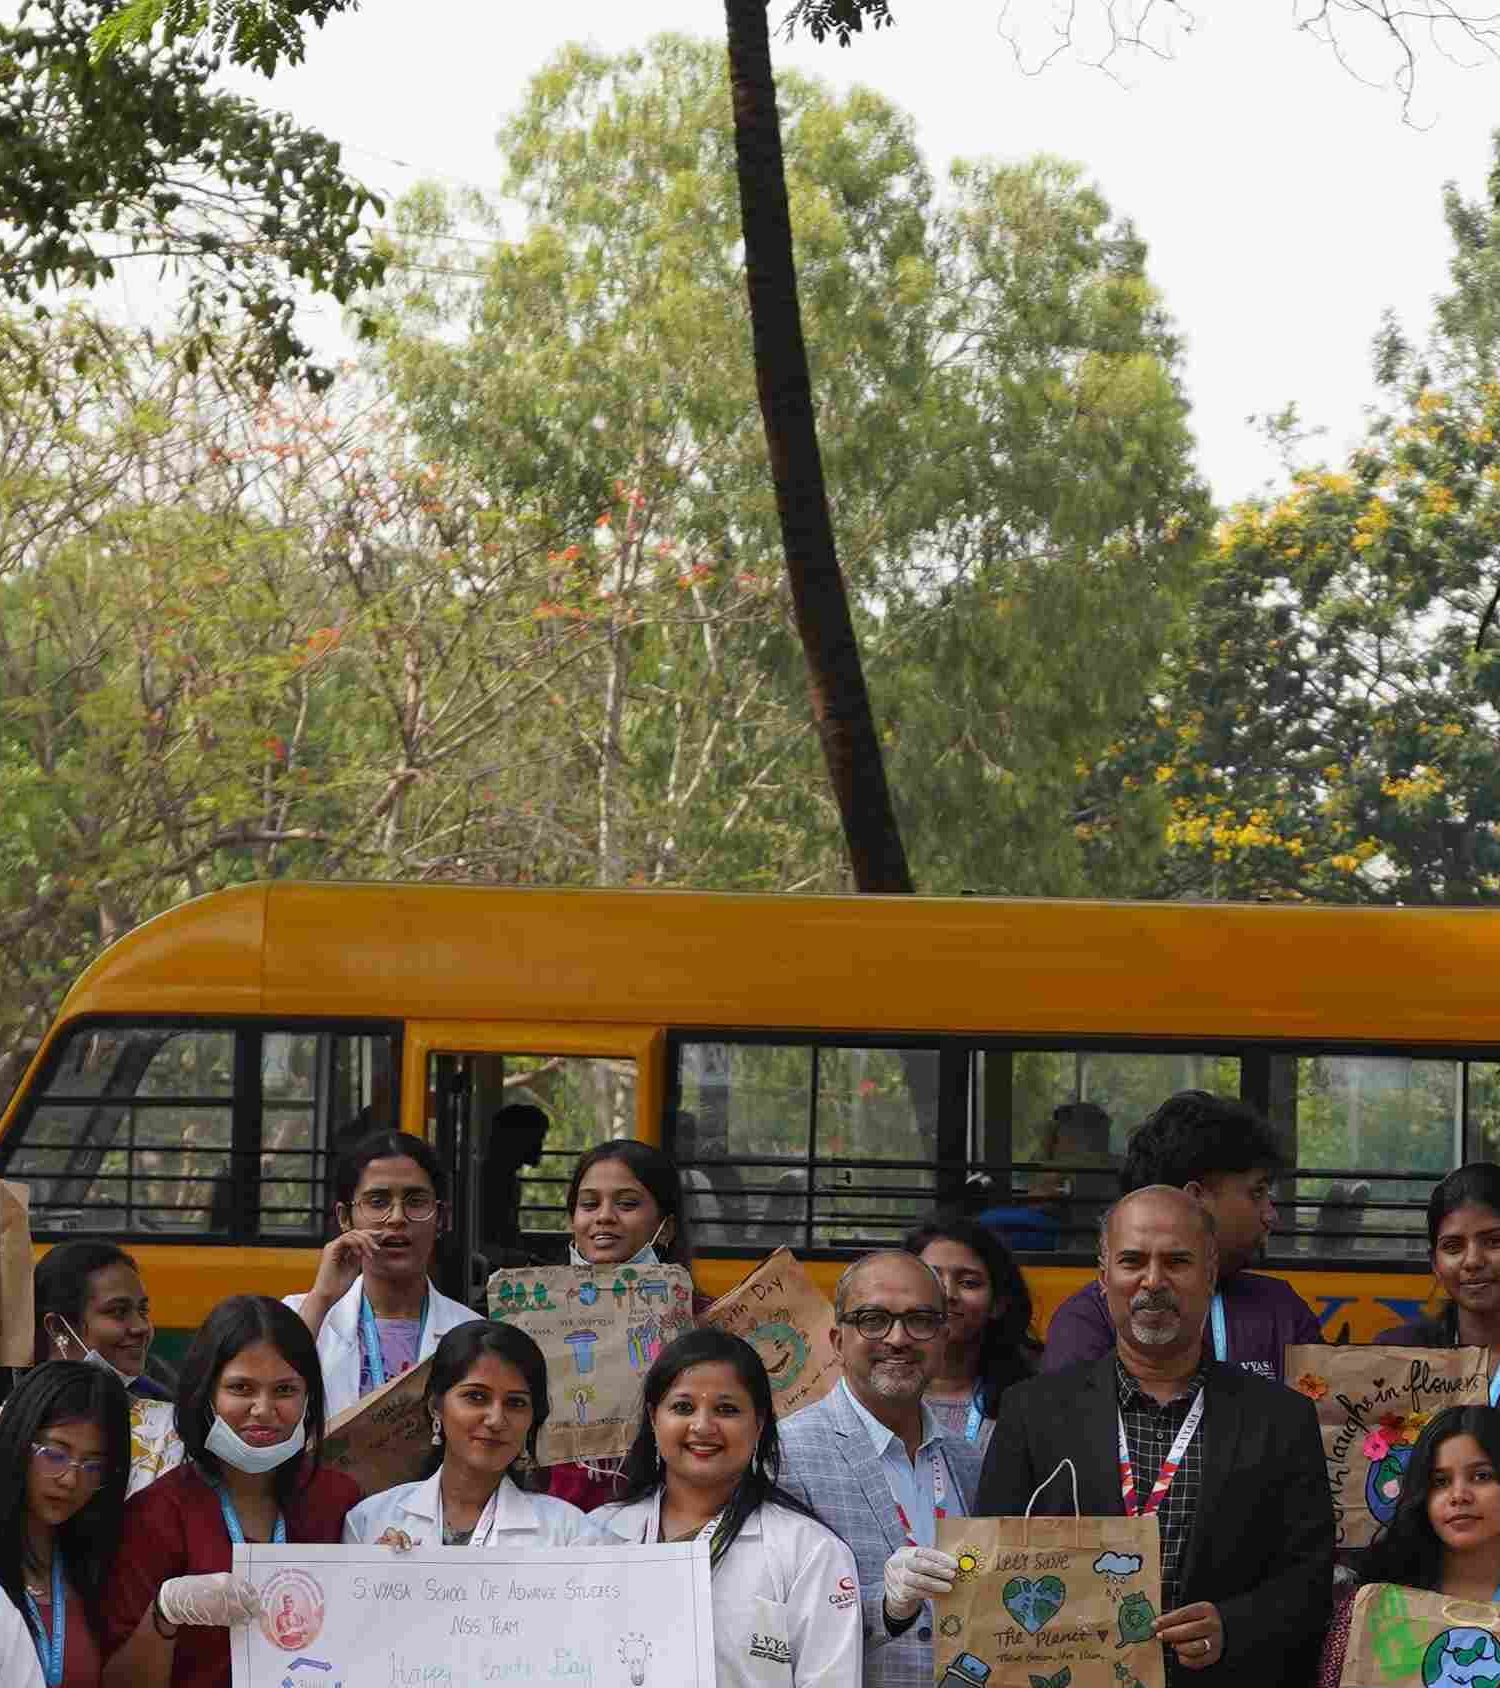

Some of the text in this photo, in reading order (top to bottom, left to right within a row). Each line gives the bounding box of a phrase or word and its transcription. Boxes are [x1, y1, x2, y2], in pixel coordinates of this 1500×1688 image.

[751, 1275, 785, 1301] Day
[1326, 1393, 1375, 1464] laughs
[1374, 1378, 1400, 1403] in
[1402, 1359, 1479, 1413] flowers
[993, 1626, 1025, 1648] The
[389, 1650, 453, 1688] Happy
